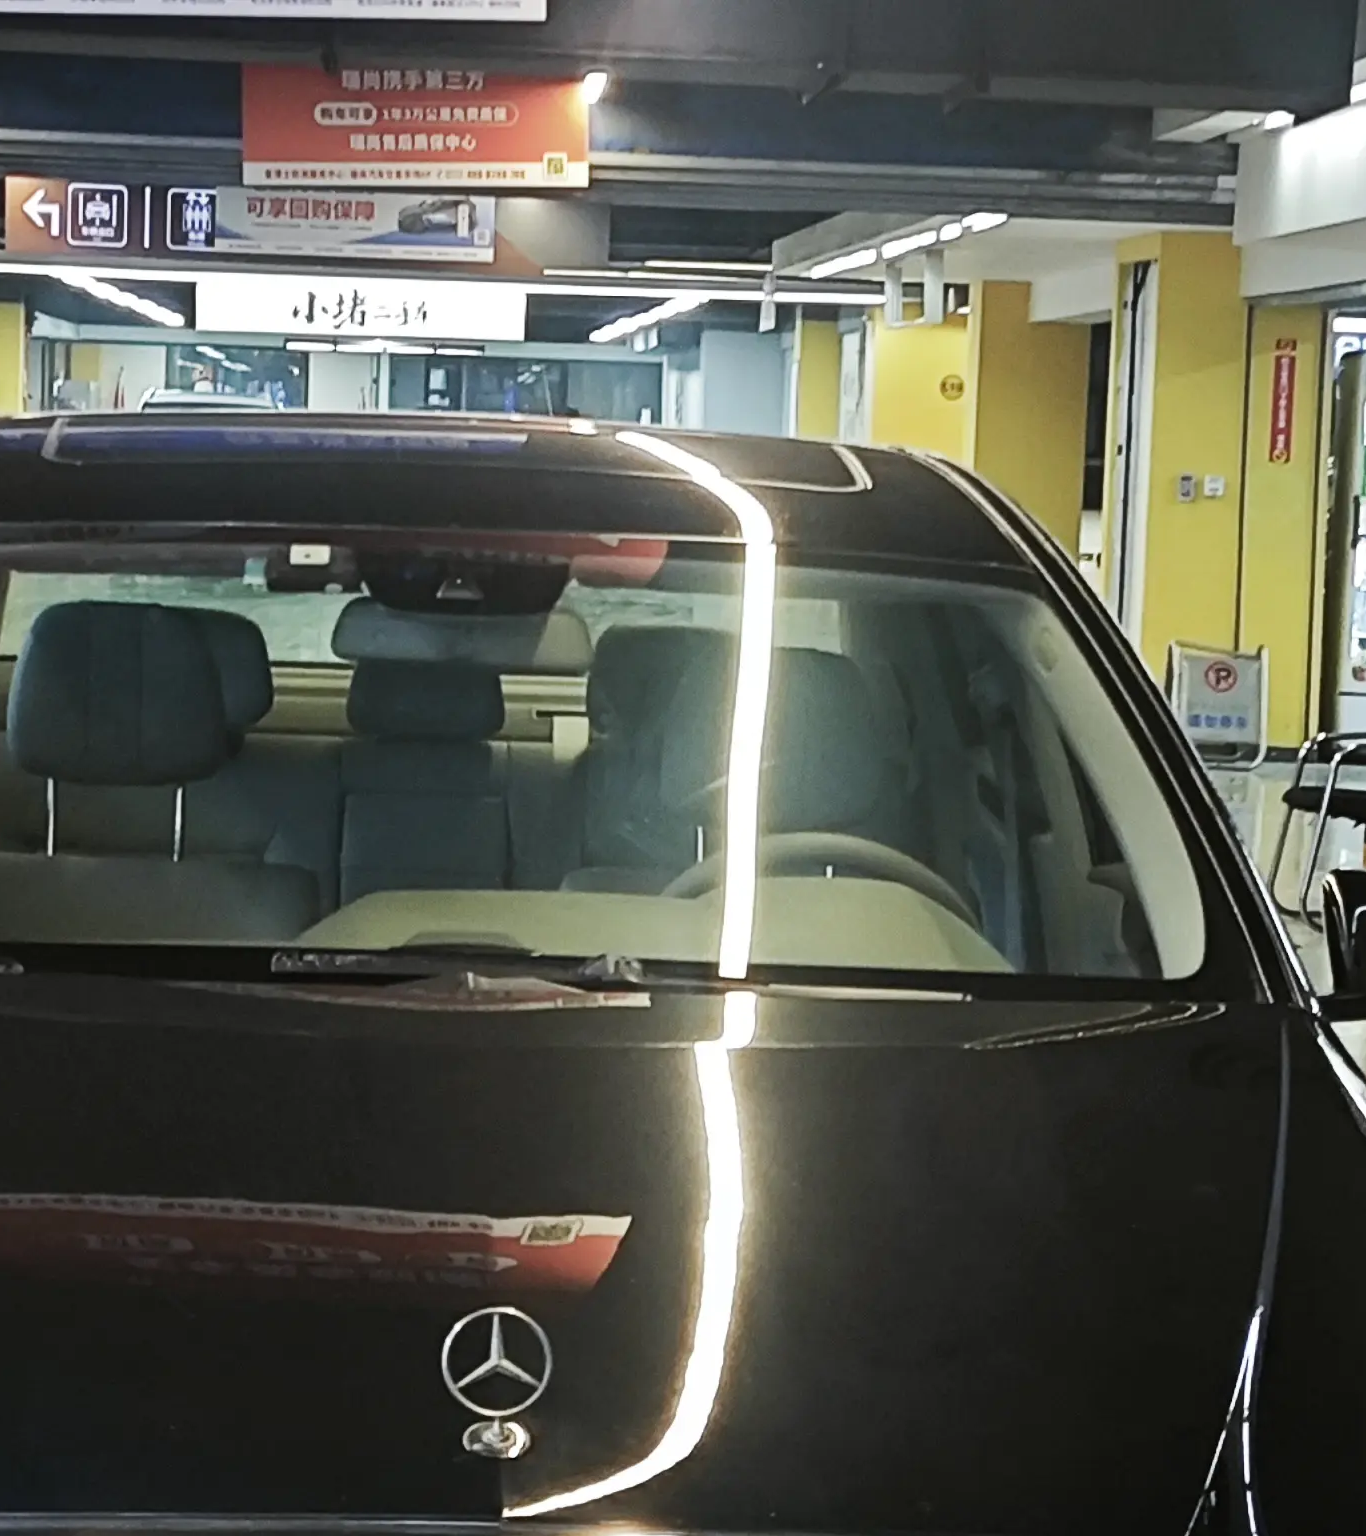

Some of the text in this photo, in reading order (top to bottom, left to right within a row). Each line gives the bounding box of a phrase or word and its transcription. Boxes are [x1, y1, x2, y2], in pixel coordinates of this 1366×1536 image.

[246, 196, 375, 221] 可享回购保障
